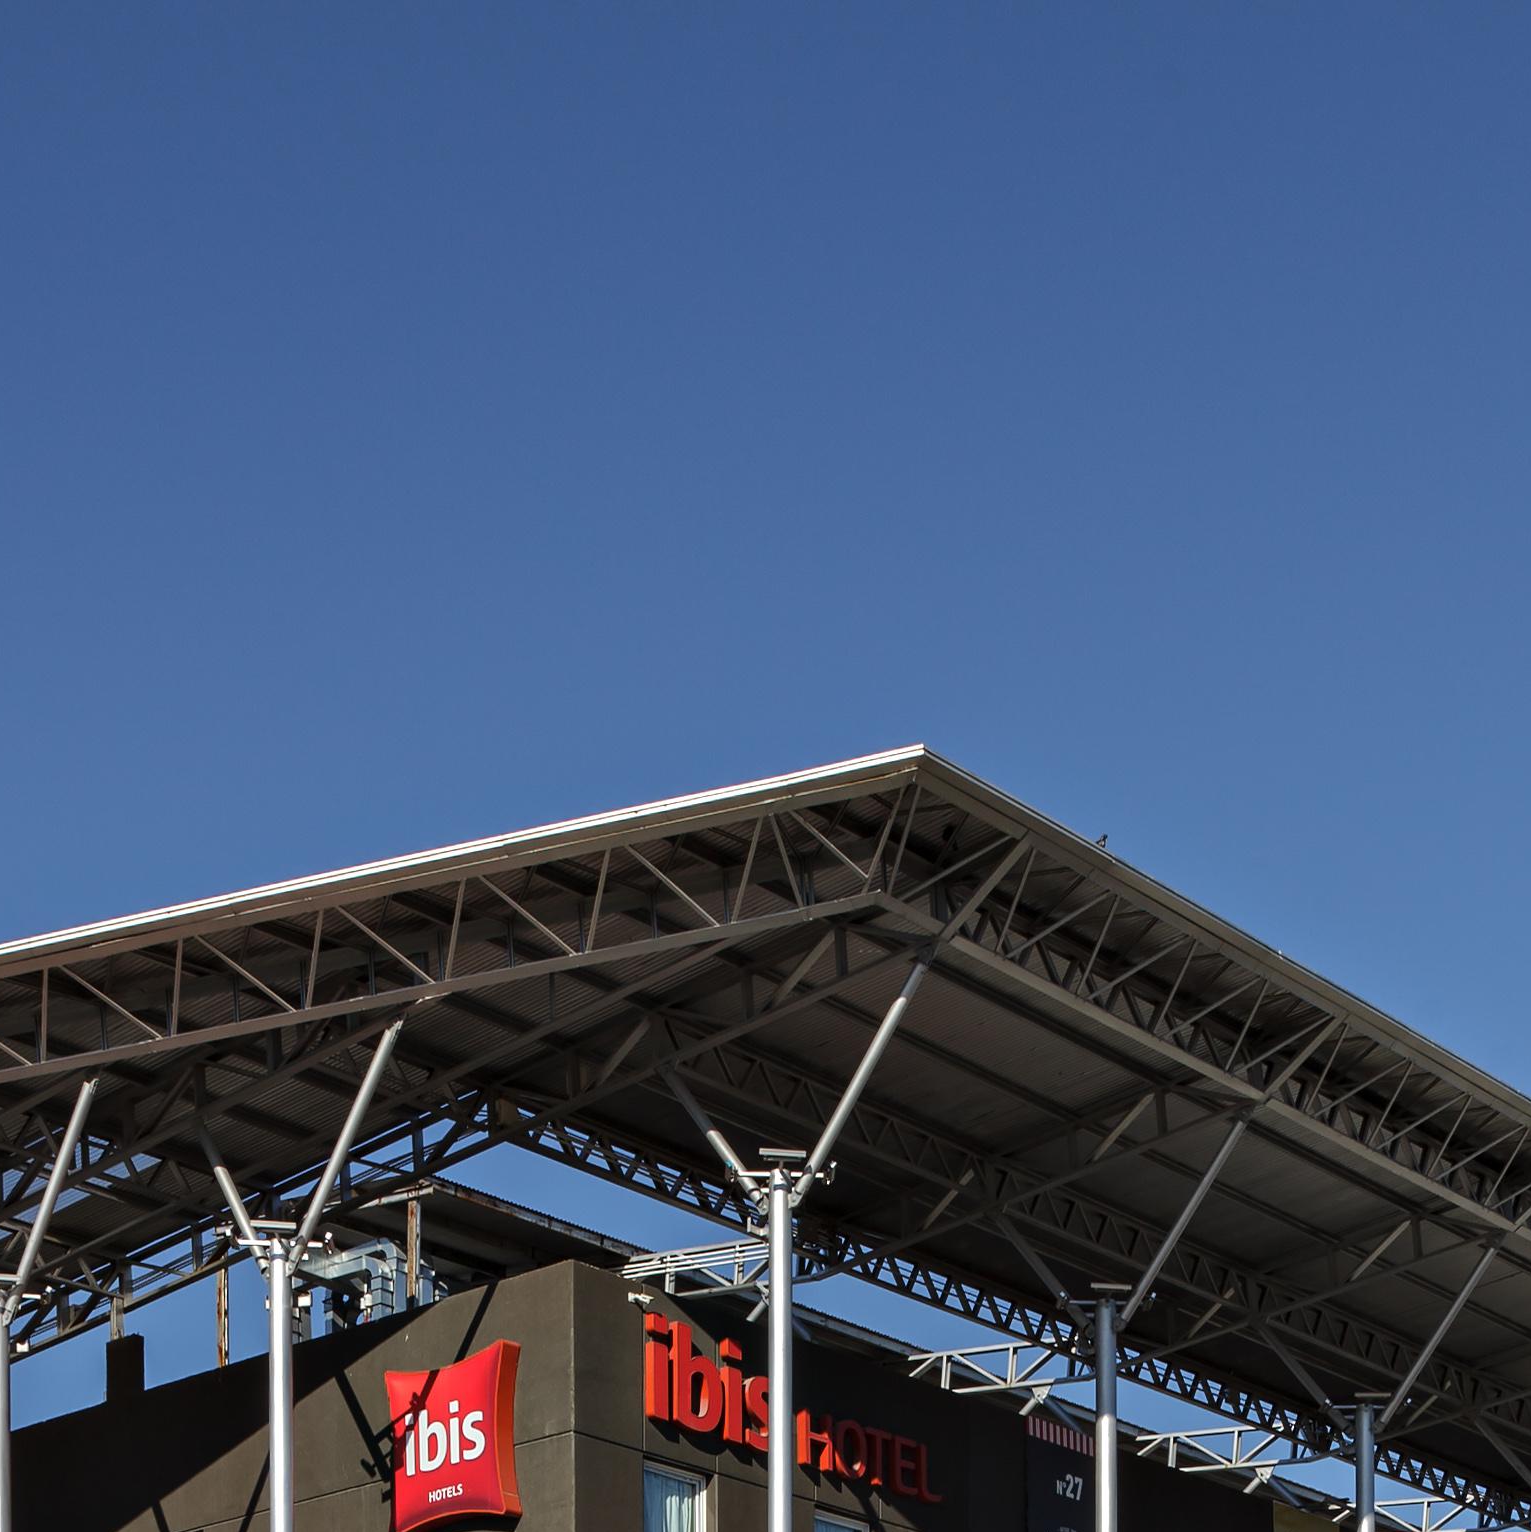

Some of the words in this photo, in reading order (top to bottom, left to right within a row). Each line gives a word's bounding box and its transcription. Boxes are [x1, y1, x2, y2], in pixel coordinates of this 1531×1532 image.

[404, 1400, 486, 1477] ibis
[645, 1313, 769, 1452] ibis
[796, 1407, 942, 1503] HOTEL
[428, 1483, 464, 1503] HOTELS
